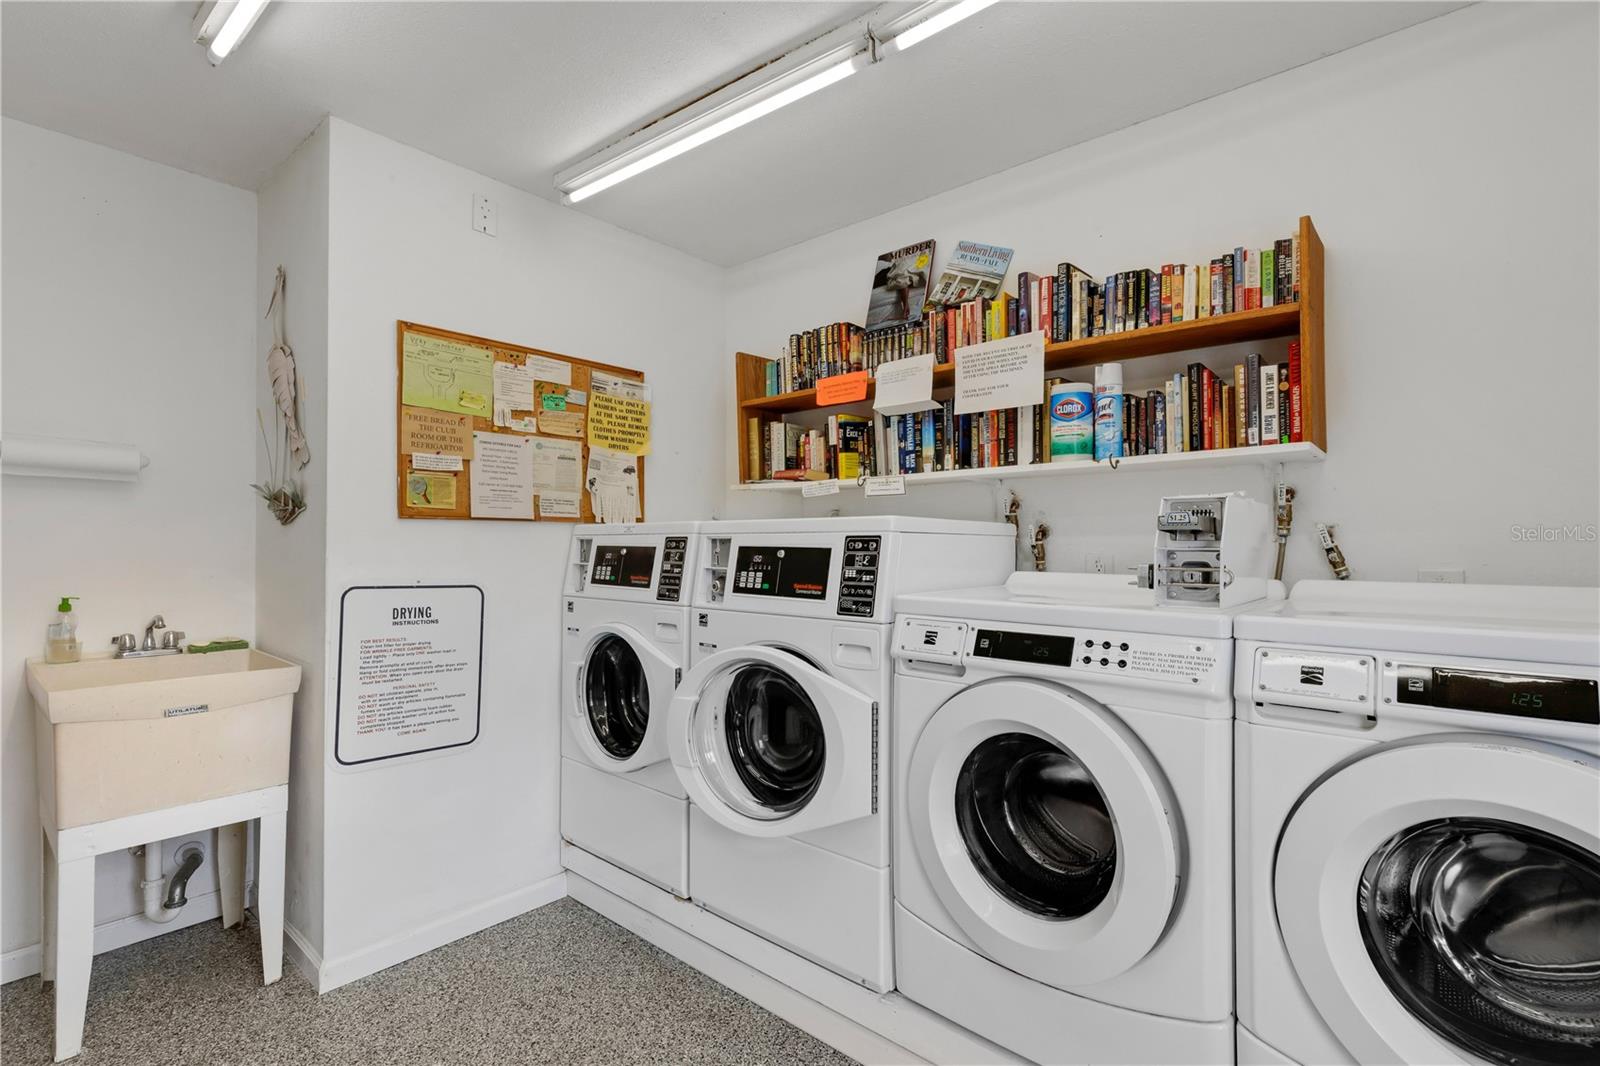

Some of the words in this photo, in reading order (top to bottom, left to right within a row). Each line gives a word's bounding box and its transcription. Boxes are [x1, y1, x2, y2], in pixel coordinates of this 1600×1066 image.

[890, 240, 932, 260] MURDER
[1058, 265, 1066, 284] BRAD
[1056, 404, 1082, 414] CLOROX
[430, 417, 456, 425] BREAD
[420, 424, 434, 432] THE
[436, 426, 456, 434] CLUB
[411, 432, 434, 440] ROOM
[436, 434, 448, 442] OR
[450, 436, 464, 444] THE
[392, 606, 432, 620] DRYING
